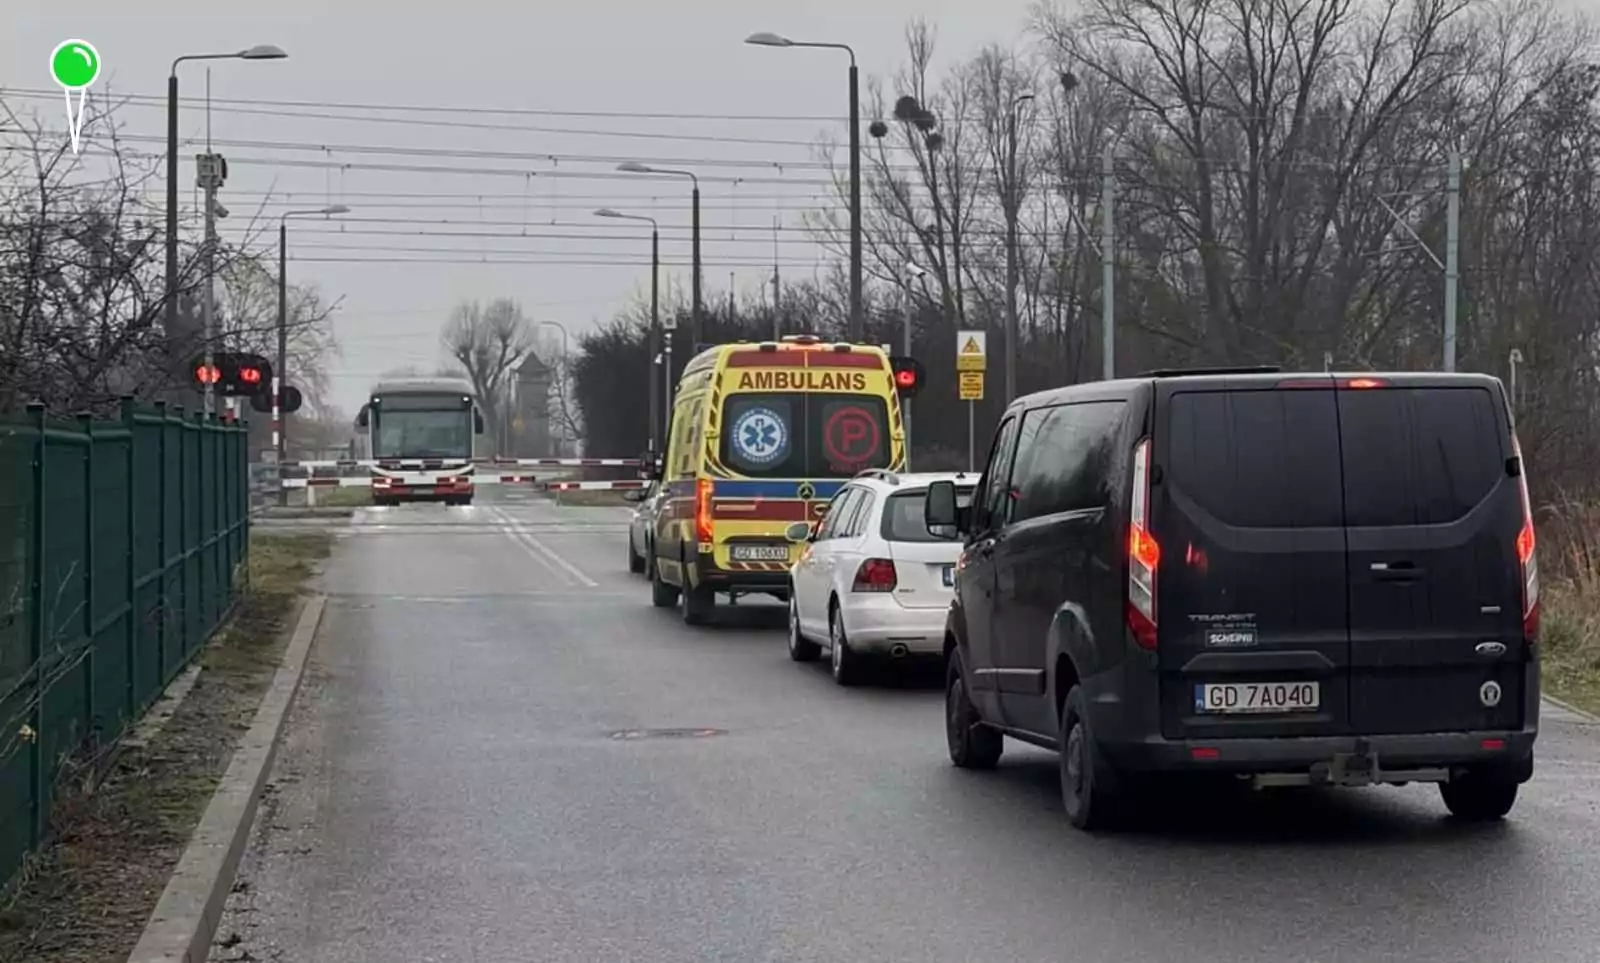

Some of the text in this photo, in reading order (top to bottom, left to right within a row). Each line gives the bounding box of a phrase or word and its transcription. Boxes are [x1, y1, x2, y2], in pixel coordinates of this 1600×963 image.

[739, 371, 866, 390] AMBULANS
[1188, 613, 1256, 621] TRANSIT
[1210, 684, 1313, 706] GD 7A040
